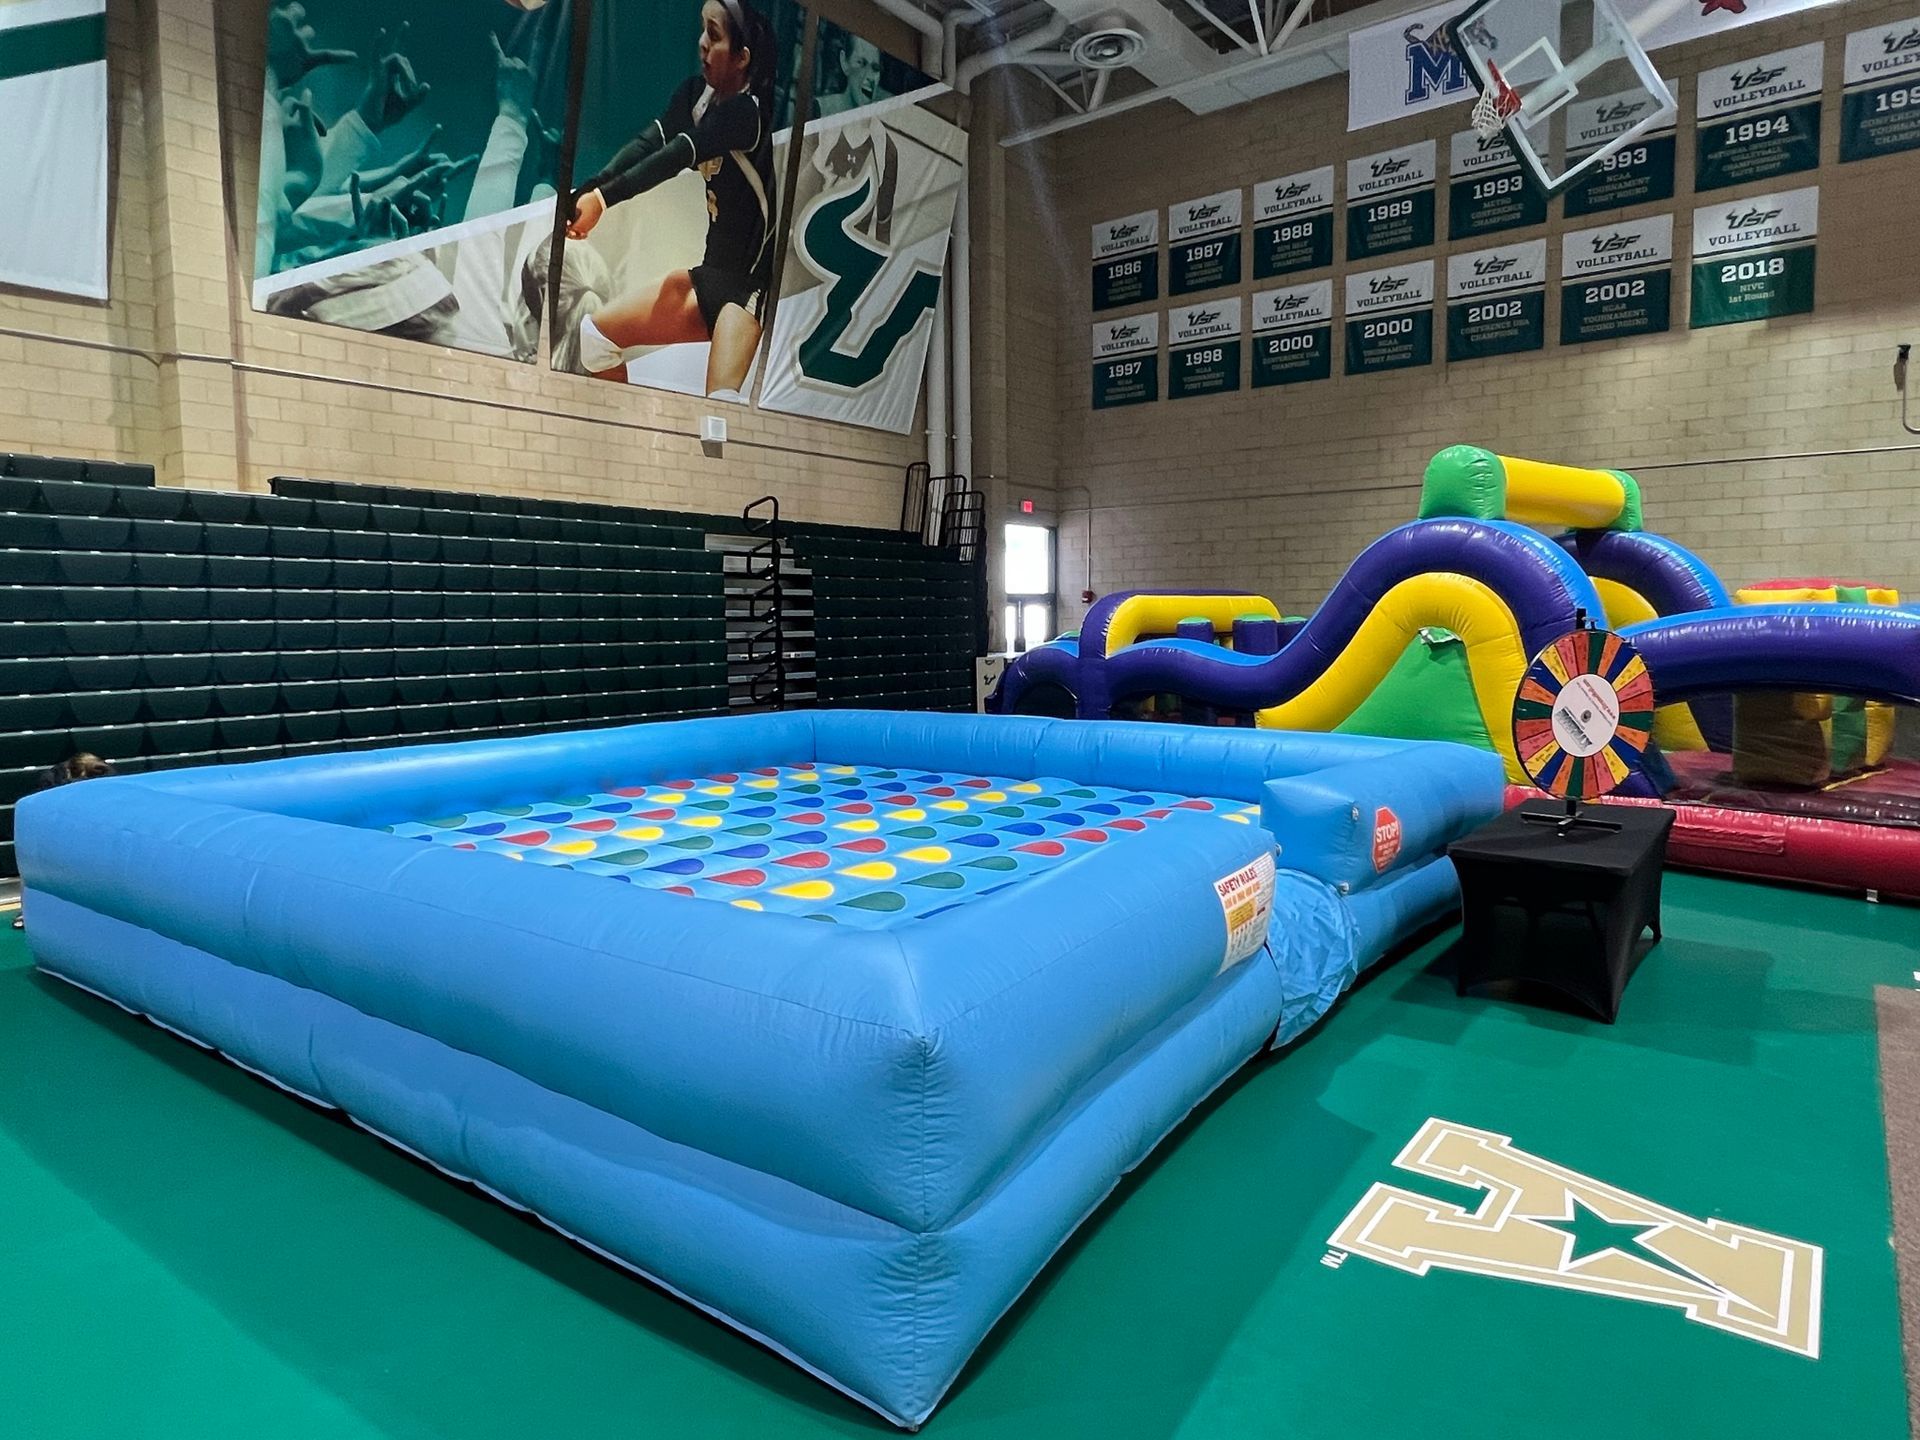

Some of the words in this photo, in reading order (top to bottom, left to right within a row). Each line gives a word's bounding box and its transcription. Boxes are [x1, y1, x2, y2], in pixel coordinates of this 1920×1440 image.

[1731, 65, 1787, 91] USF
[1713, 80, 1806, 109] VOLLEYBALL
[1596, 101, 1646, 124] USF
[1725, 115, 1790, 145] 1994
[1370, 157, 1411, 178] USF
[1597, 147, 1648, 173] 993
[1358, 170, 1424, 192] VOLLEYBALL
[1473, 175, 1523, 200] 1993
[1275, 182, 1312, 201] USF
[1188, 203, 1222, 222] USF
[1264, 195, 1324, 215] VOLLEYBALL
[1368, 200, 1413, 222] 1989
[1178, 215, 1233, 235] VOLLEYBALL
[1726, 207, 1783, 230] USF
[1273, 222, 1314, 244] 1988
[1708, 222, 1801, 247] VOLLEYBALL
[1100, 235, 1150, 254] VOLLEYBALL
[1186, 242, 1224, 263] 1987
[1592, 233, 1642, 254] USF
[1473, 257, 1518, 276] USF
[1576, 247, 1658, 269] VOLLEYBALL
[1107, 260, 1142, 280] 1986
[1720, 257, 1786, 284] 2018
[1369, 276, 1409, 294] USF
[1459, 271, 1533, 290] VOLLEYBALL
[1739, 281, 1765, 293] NIVC
[1356, 290, 1423, 308] VOLLEYBALL
[1585, 279, 1646, 304] 2002
[1744, 289, 1776, 301] Round
[1273, 294, 1310, 312] USF
[1467, 300, 1523, 324] 2002
[1188, 310, 1222, 327] USF
[1262, 308, 1323, 325] VOLLEYBALL
[1110, 325, 1141, 341] USF
[1177, 323, 1232, 339] VOLLEYBALL
[1363, 318, 1414, 340] 2000
[1101, 338, 1150, 352] VOLLEYBALL
[1268, 334, 1314, 354] 2000
[1185, 348, 1224, 367] 1998
[1108, 362, 1142, 378] 1997
[1218, 876, 1241, 897] SAFETY
[1239, 867, 1257, 885] RULES
